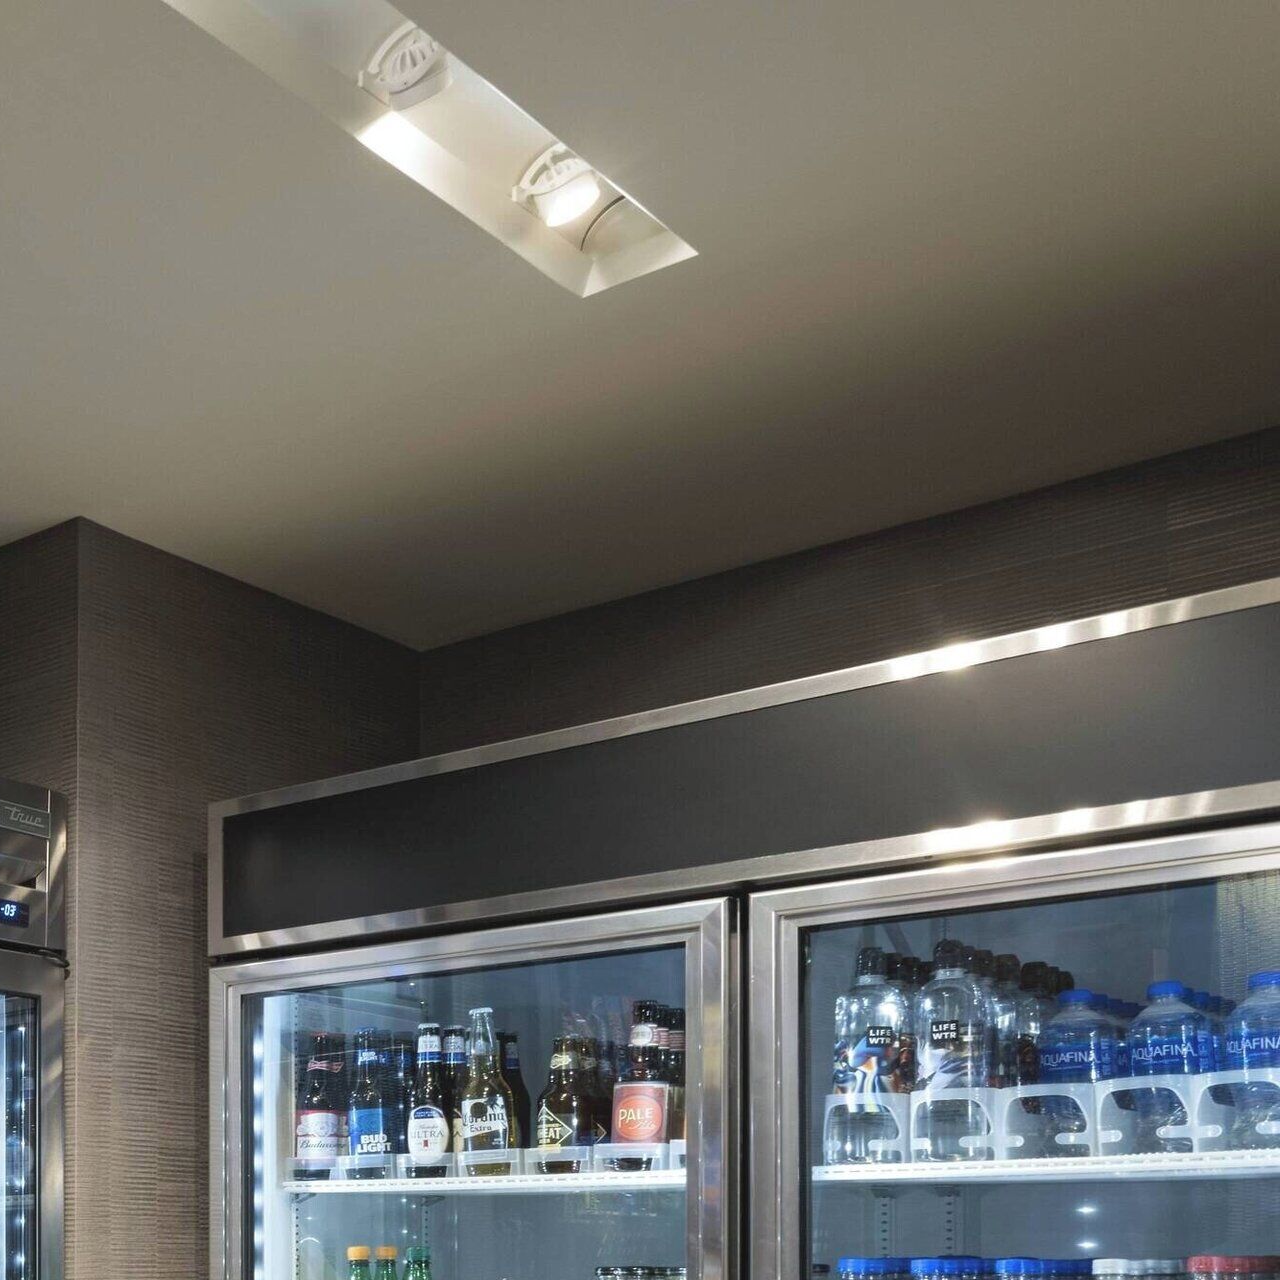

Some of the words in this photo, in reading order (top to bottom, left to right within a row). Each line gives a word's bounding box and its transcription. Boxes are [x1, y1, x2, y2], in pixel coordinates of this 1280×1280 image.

[931, 1022, 957, 1031] LIFE
[868, 1028, 892, 1037] LIFE
[931, 1030, 957, 1040] WTR
[868, 1036, 892, 1045] WTR
[1132, 1042, 1195, 1060] AQUAFINA
[1041, 1051, 1098, 1066] AQUAFINA
[618, 1108, 655, 1130] PALE
[360, 1134, 388, 1144] BUD
[356, 1142, 392, 1154] LIGHT
